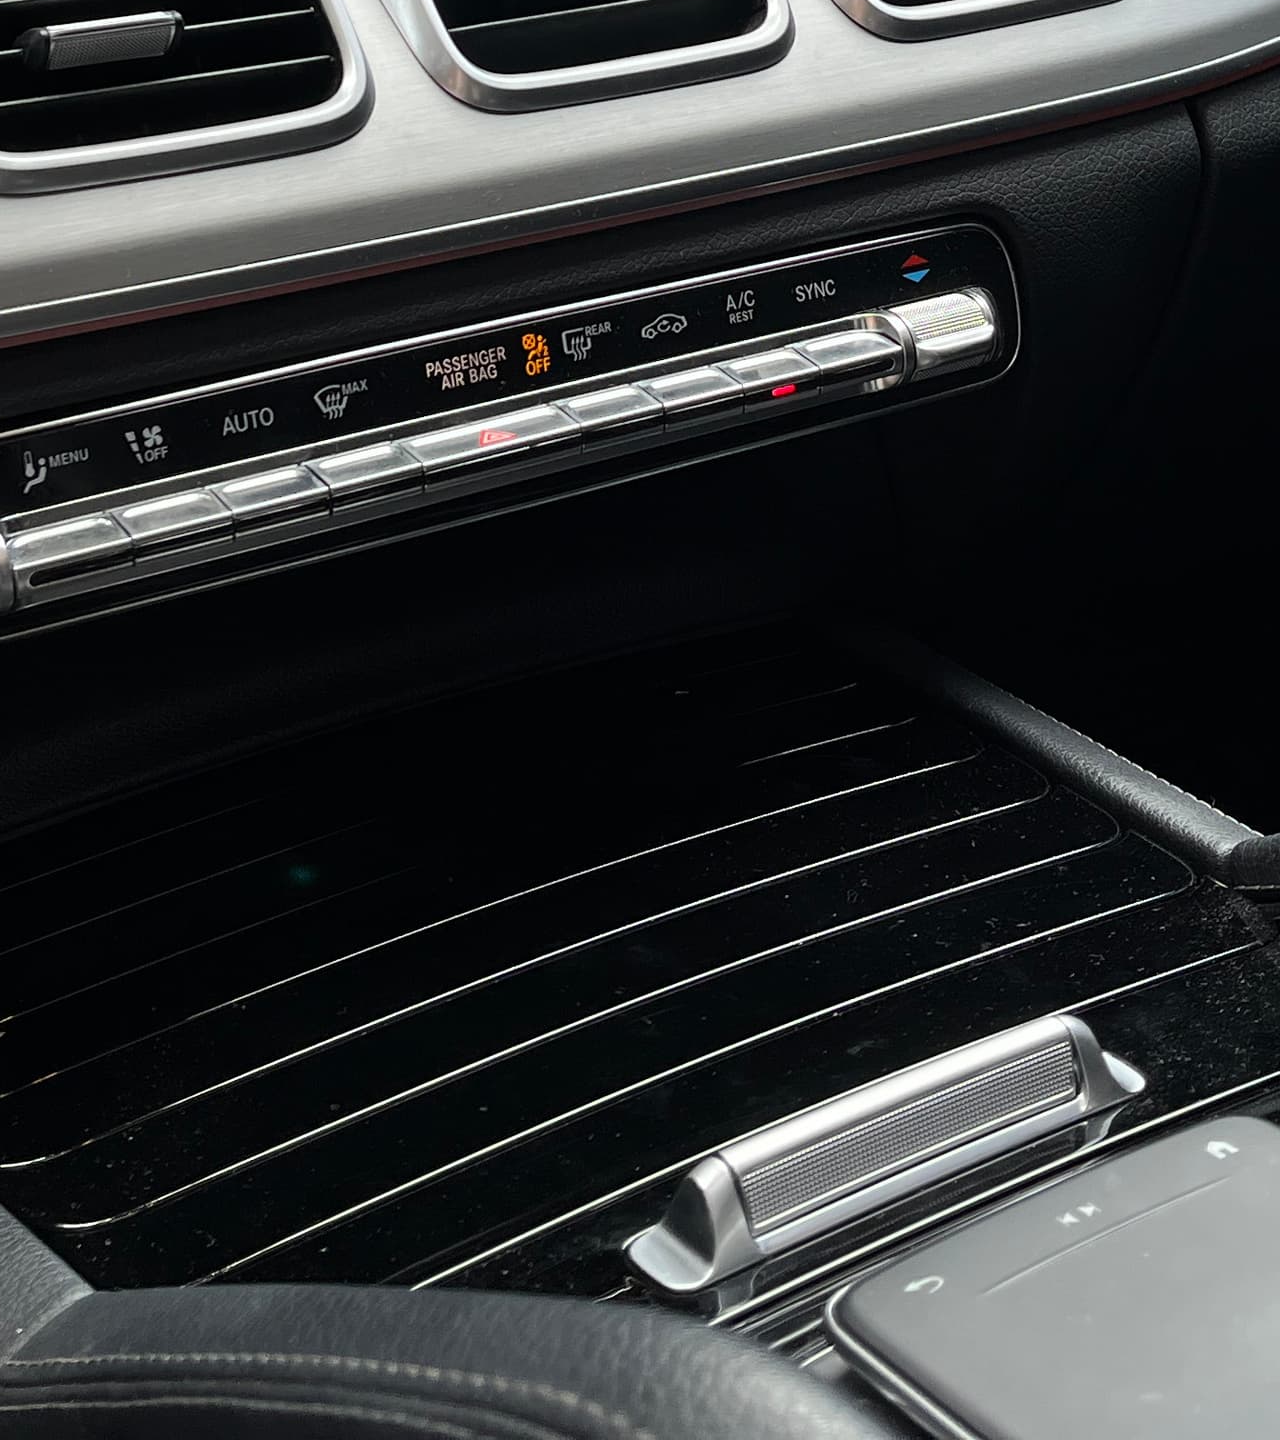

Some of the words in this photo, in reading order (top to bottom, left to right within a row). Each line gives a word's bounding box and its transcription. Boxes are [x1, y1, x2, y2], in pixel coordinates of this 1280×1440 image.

[724, 288, 756, 312] A/C
[794, 278, 838, 304] SYNC
[728, 308, 756, 325] REST
[584, 320, 613, 337] REAR
[425, 346, 508, 379] PASSENGER
[524, 356, 552, 376] OFF
[341, 378, 369, 396] MAX
[440, 370, 467, 391] AIR
[468, 364, 499, 385] BAG
[221, 407, 275, 437] AUTO
[48, 447, 90, 468] MENU
[143, 445, 170, 463] OFF
